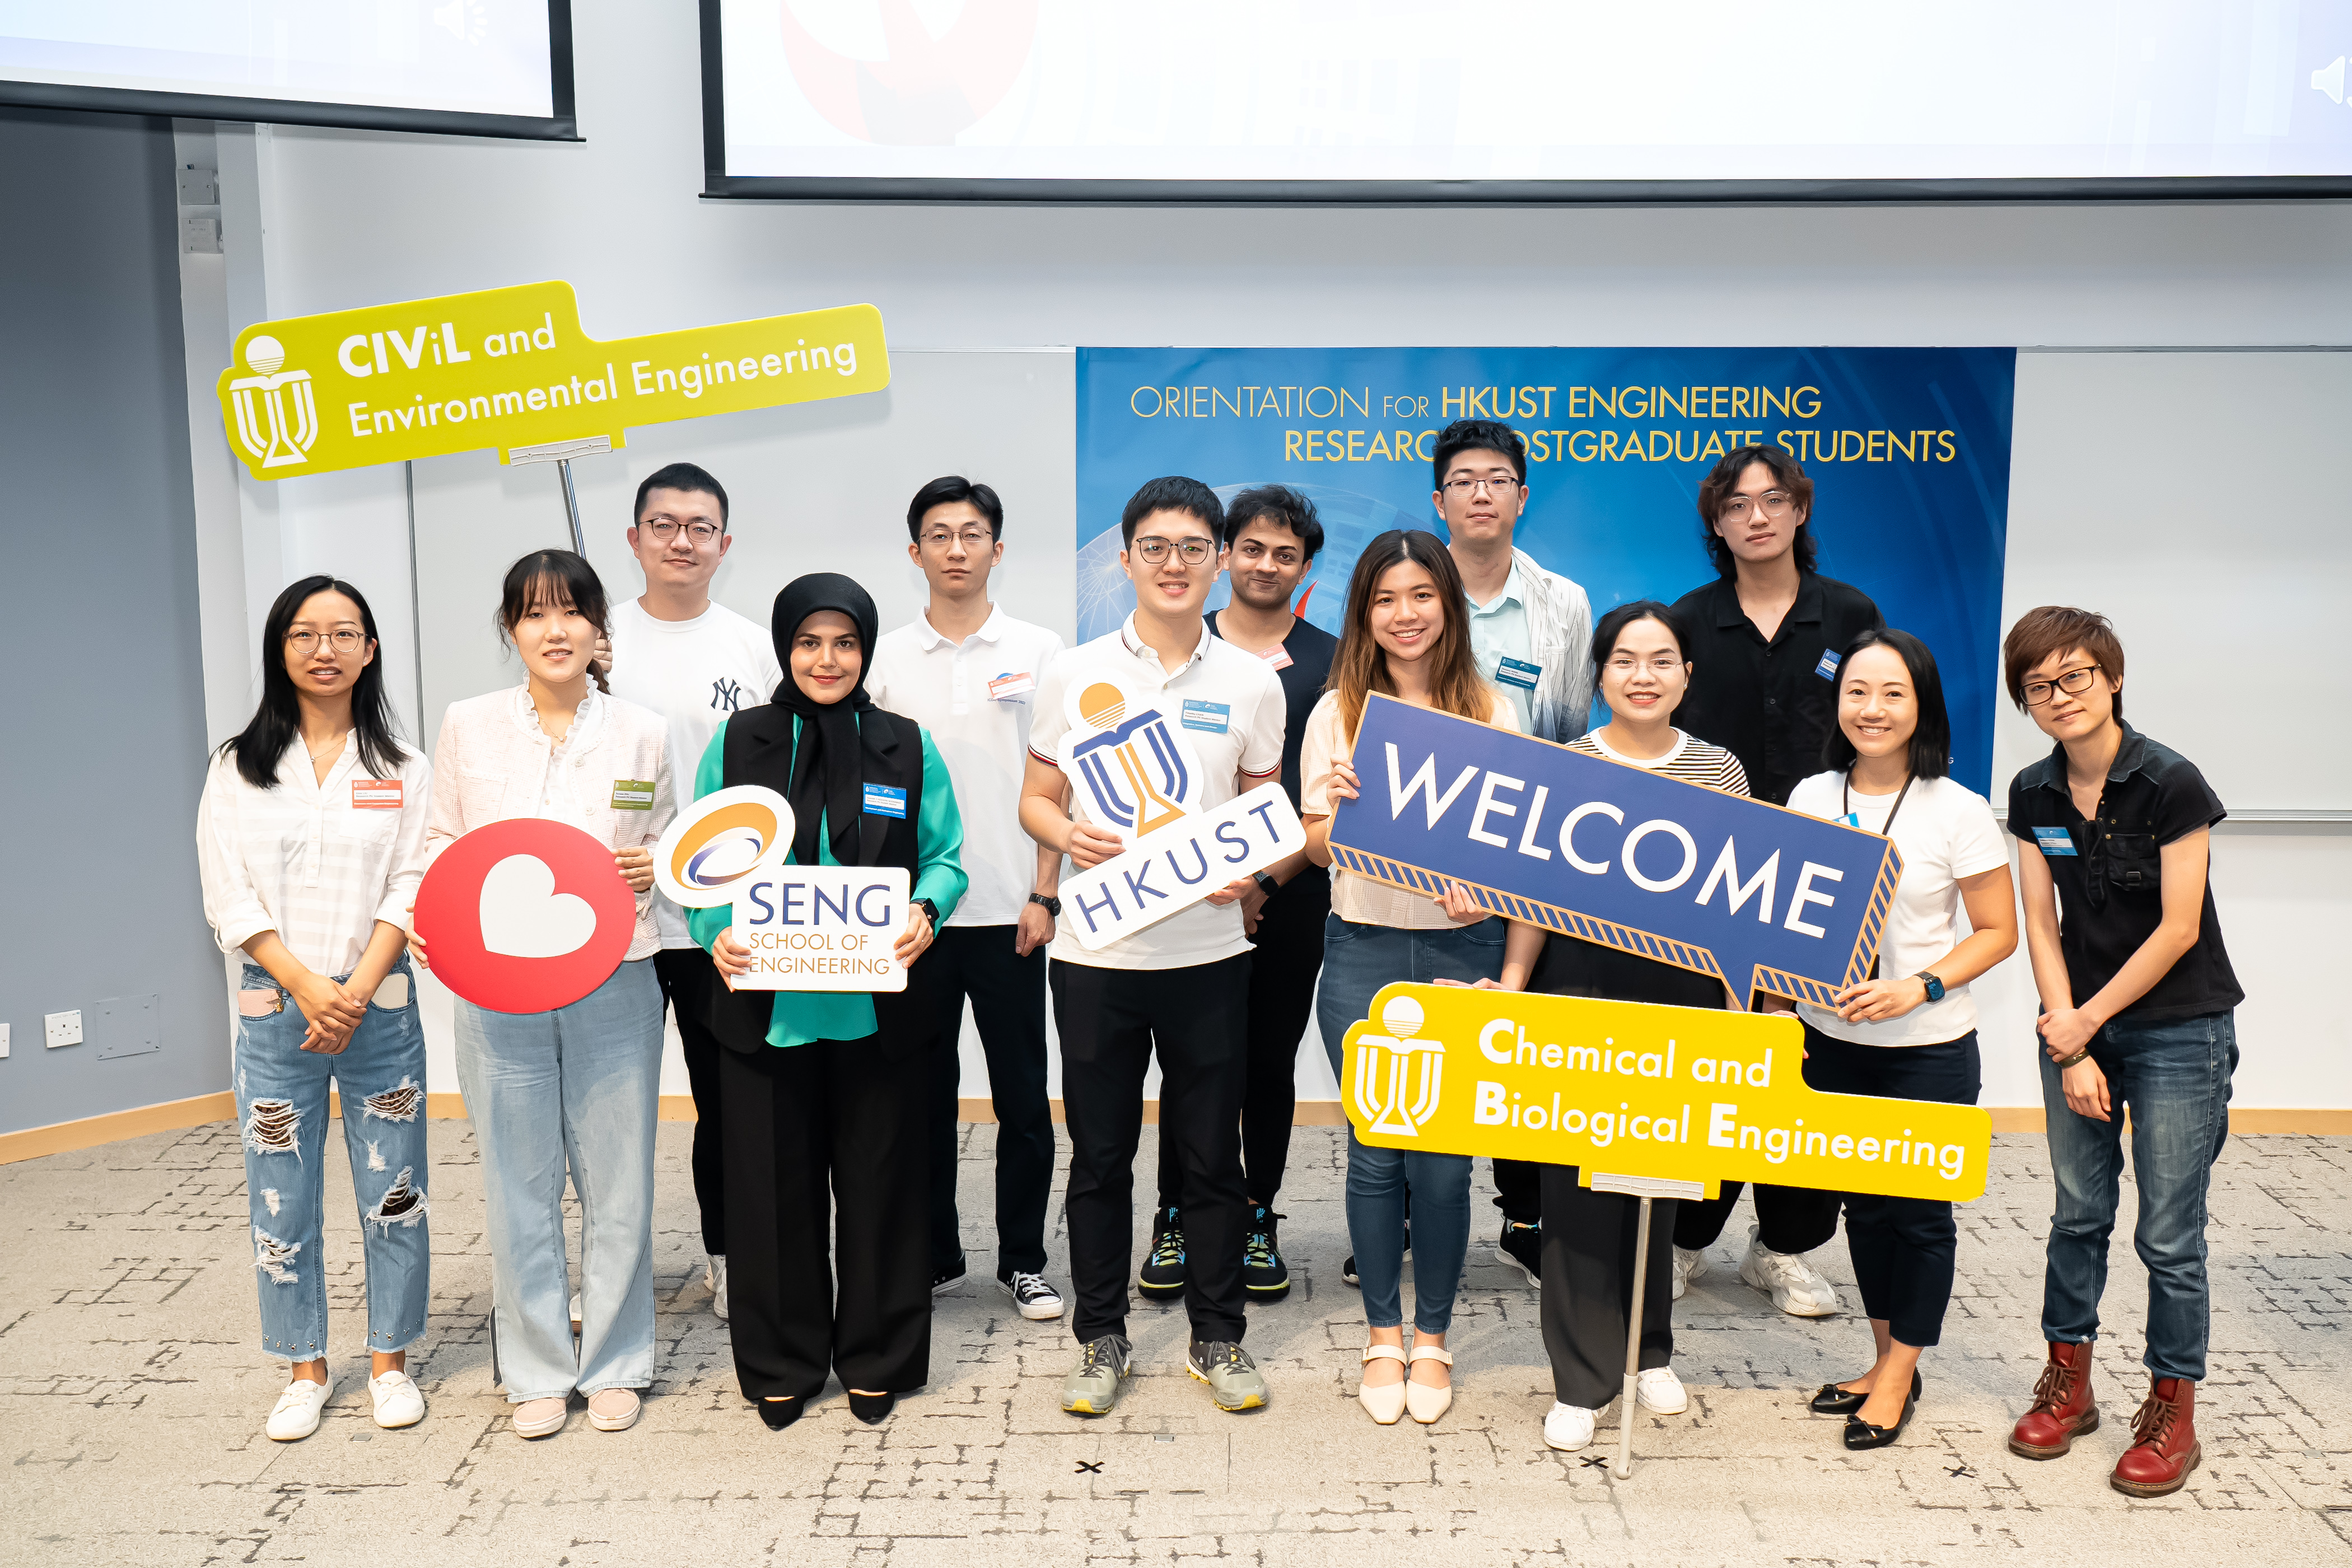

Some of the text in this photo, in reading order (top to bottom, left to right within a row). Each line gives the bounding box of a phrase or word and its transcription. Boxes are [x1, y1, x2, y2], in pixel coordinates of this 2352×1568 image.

[338, 312, 556, 377] CIViL and
[349, 339, 857, 436] Environmental Engineering
[1131, 386, 1821, 418] ORIENTATION FOR HKUST ENGINEERING
[1286, 430, 1955, 461] RESEARC STGRADUATE STUDENTS
[1075, 800, 1280, 933] HKUST
[1385, 742, 1844, 938] WELCOME
[749, 882, 890, 927] SENG
[749, 932, 868, 951] SCHOOL OF
[751, 956, 890, 975] ENGINEERING
[1480, 1019, 1772, 1087] Chemical and
[1474, 1081, 1964, 1179] Biological Engineering
